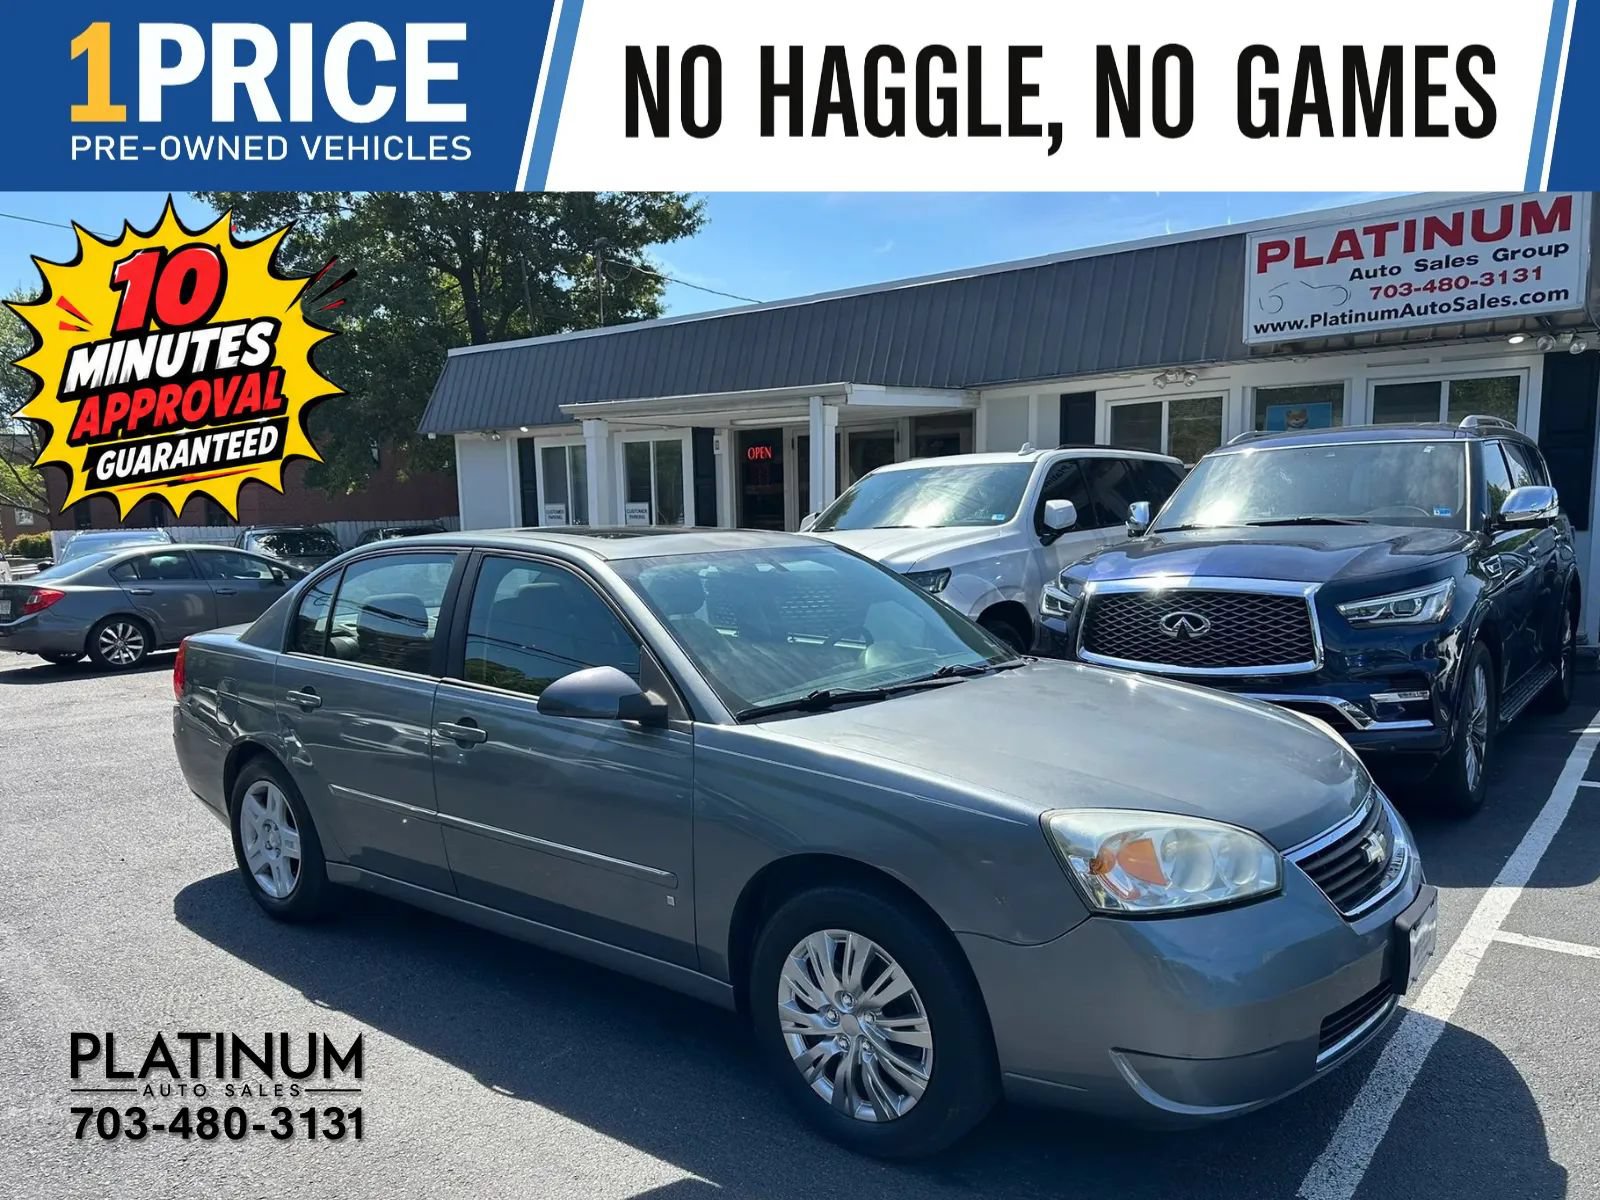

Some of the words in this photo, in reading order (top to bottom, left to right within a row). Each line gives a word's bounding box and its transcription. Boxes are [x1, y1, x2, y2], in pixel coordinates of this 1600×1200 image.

[1256, 195, 1573, 274] PLATINUM
[1349, 263, 1402, 281] Auto
[1414, 253, 1479, 273] Sales
[1492, 242, 1570, 262] Group
[1369, 266, 1542, 300] 703-480-3131
[1253, 287, 1569, 335] www.PlatinumAutoSales.com
[747, 446, 772, 460] OPEN
